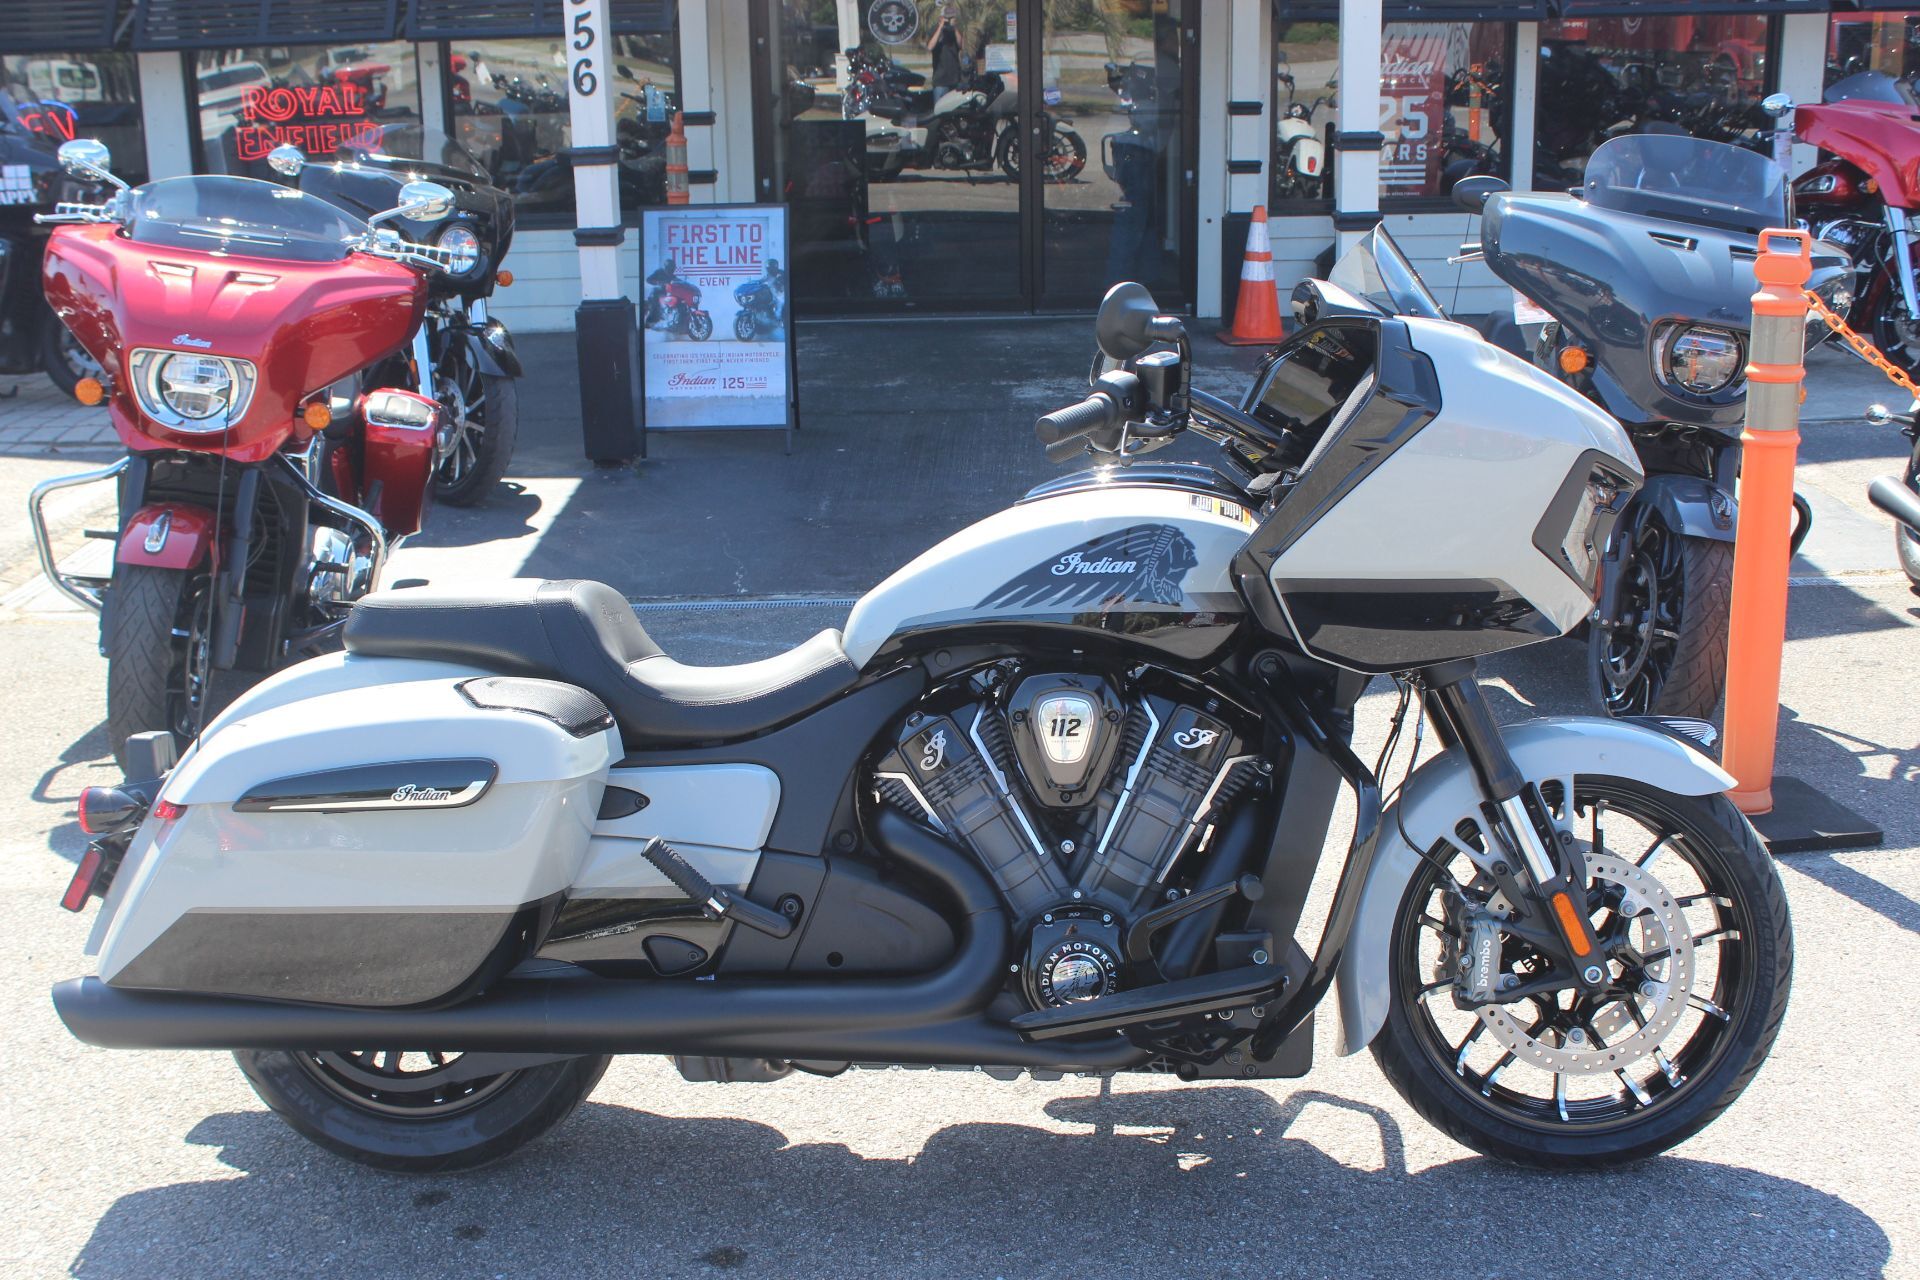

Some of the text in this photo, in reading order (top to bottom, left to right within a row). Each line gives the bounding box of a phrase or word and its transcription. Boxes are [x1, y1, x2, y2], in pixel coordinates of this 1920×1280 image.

[570, 0, 597, 96] 56
[240, 85, 365, 121] ROYAL
[1380, 95, 1429, 139] 25
[235, 122, 384, 160] ENFIELD
[1381, 144, 1428, 160] ARS
[736, 223, 762, 242] TO
[668, 245, 762, 265] THE LINE
[700, 277, 731, 286] EVENT
[668, 373, 716, 386] Indian
[722, 377, 745, 389] 125
[1050, 552, 1138, 576] Indian
[1050, 718, 1082, 737] 112
[391, 784, 452, 802] Indian
[1477, 939, 1492, 987] brembo
[1041, 952, 1060, 1003] INDIAN
